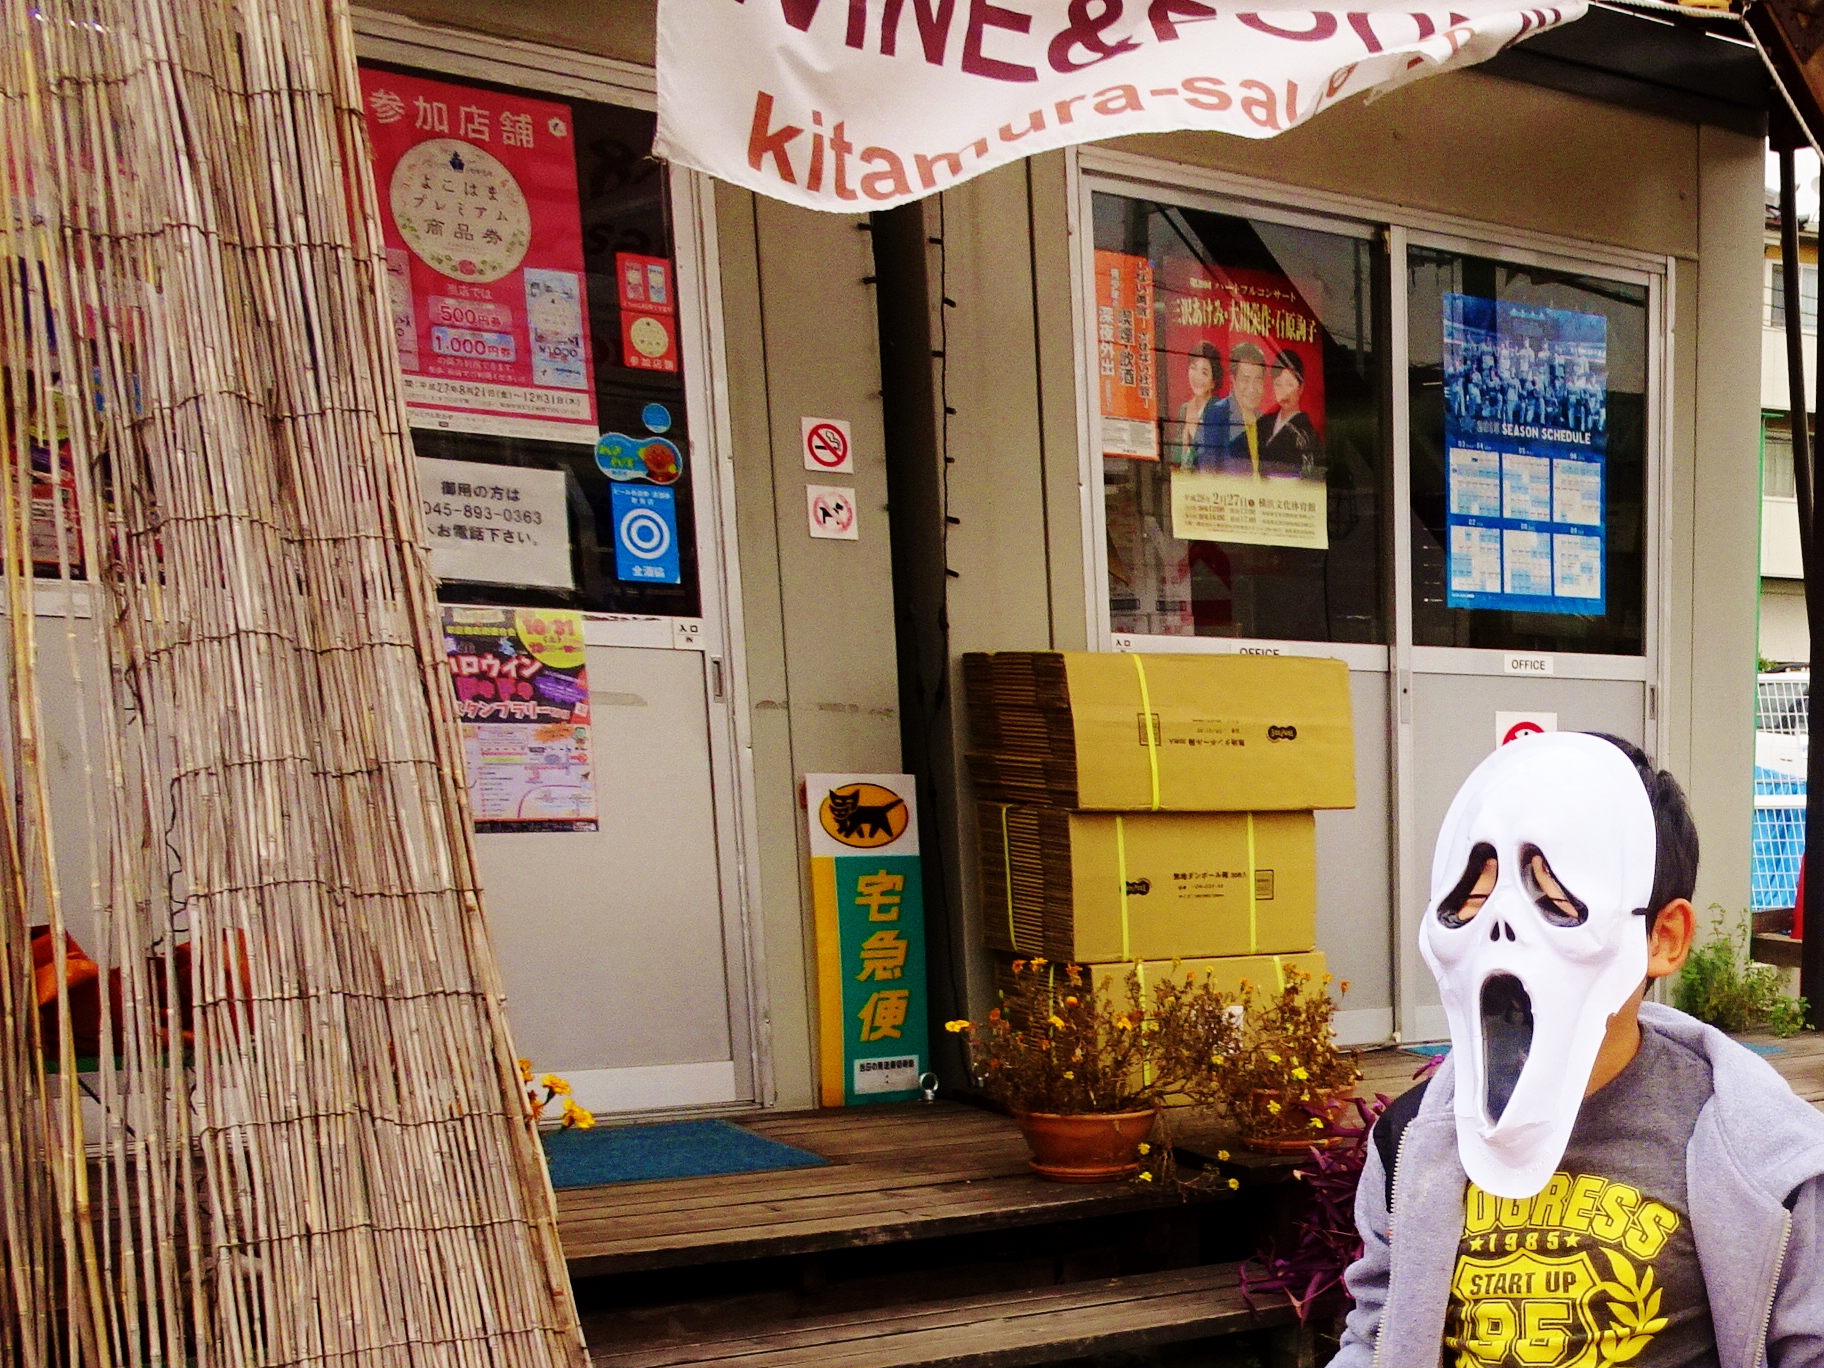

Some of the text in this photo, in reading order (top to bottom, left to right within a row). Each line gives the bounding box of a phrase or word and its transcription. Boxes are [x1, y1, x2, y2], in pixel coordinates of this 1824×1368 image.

[369, 87, 535, 149] 参加店舗
[421, 174, 499, 203] よこはま
[413, 193, 509, 222] プレミアム
[423, 218, 503, 245] 商品券
[1502, 423, 1539, 439] SEASON
[1541, 428, 1592, 445] SCHEDULE
[441, 480, 521, 503] 御用の方は
[423, 501, 543, 526] 045-893-0363
[1511, 657, 1546, 672] OFFICE
[855, 869, 911, 1042] 宅急便
[1464, 1171, 1680, 1260] OGRESS
[1488, 1231, 1559, 1252] 1985
[1470, 1270, 1577, 1296] START UP
